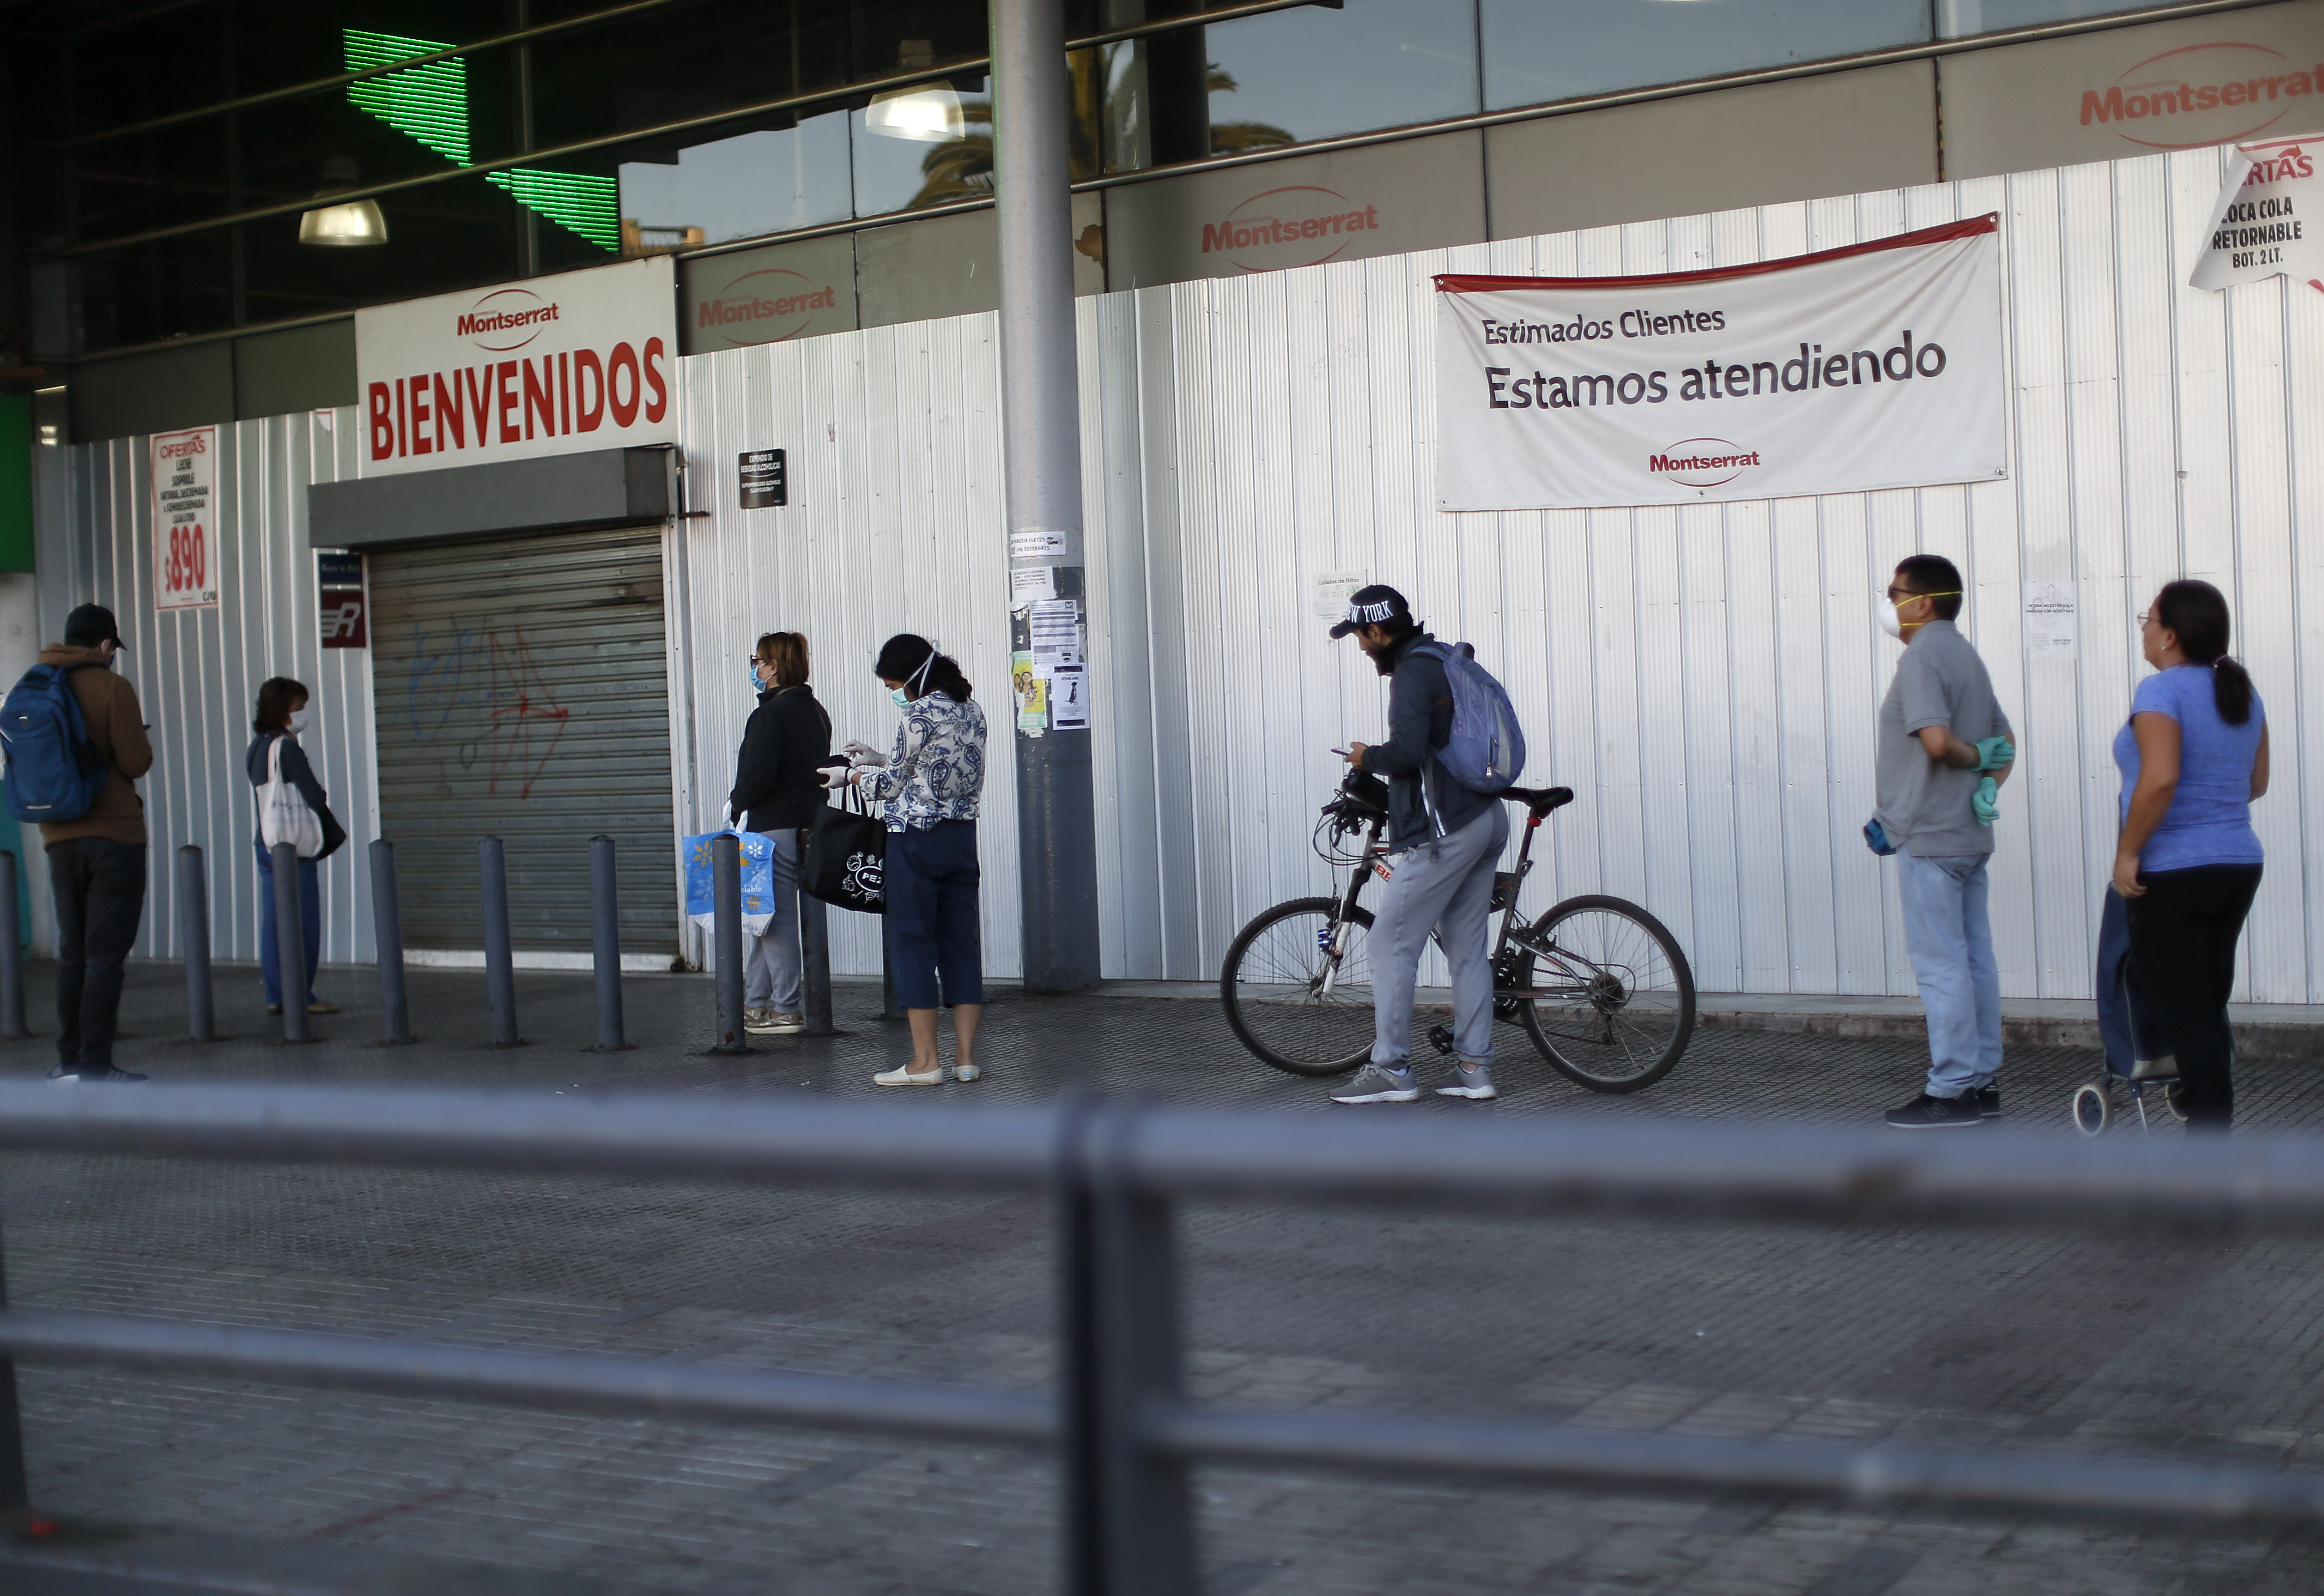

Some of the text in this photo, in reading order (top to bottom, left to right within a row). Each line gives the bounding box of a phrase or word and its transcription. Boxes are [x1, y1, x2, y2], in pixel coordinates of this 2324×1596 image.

[2080, 63, 2324, 126] Montserrat
[2260, 196, 2294, 219] COLA
[1202, 204, 1378, 253] Montserrat
[2213, 221, 2302, 250] RETORNABLE
[2233, 248, 2283, 268] BOT. 2 LT.
[457, 302, 559, 336] Montserrat
[698, 285, 835, 328] Montserrat
[1482, 309, 1726, 345] Estimados Clientes
[1485, 329, 1947, 409] Estamos atendiendo
[368, 336, 667, 461] BIENVENIDOS
[159, 439, 206, 459] OFERTAS
[1650, 451, 1760, 472] Montserrat
[1362, 600, 1394, 623] YORK
